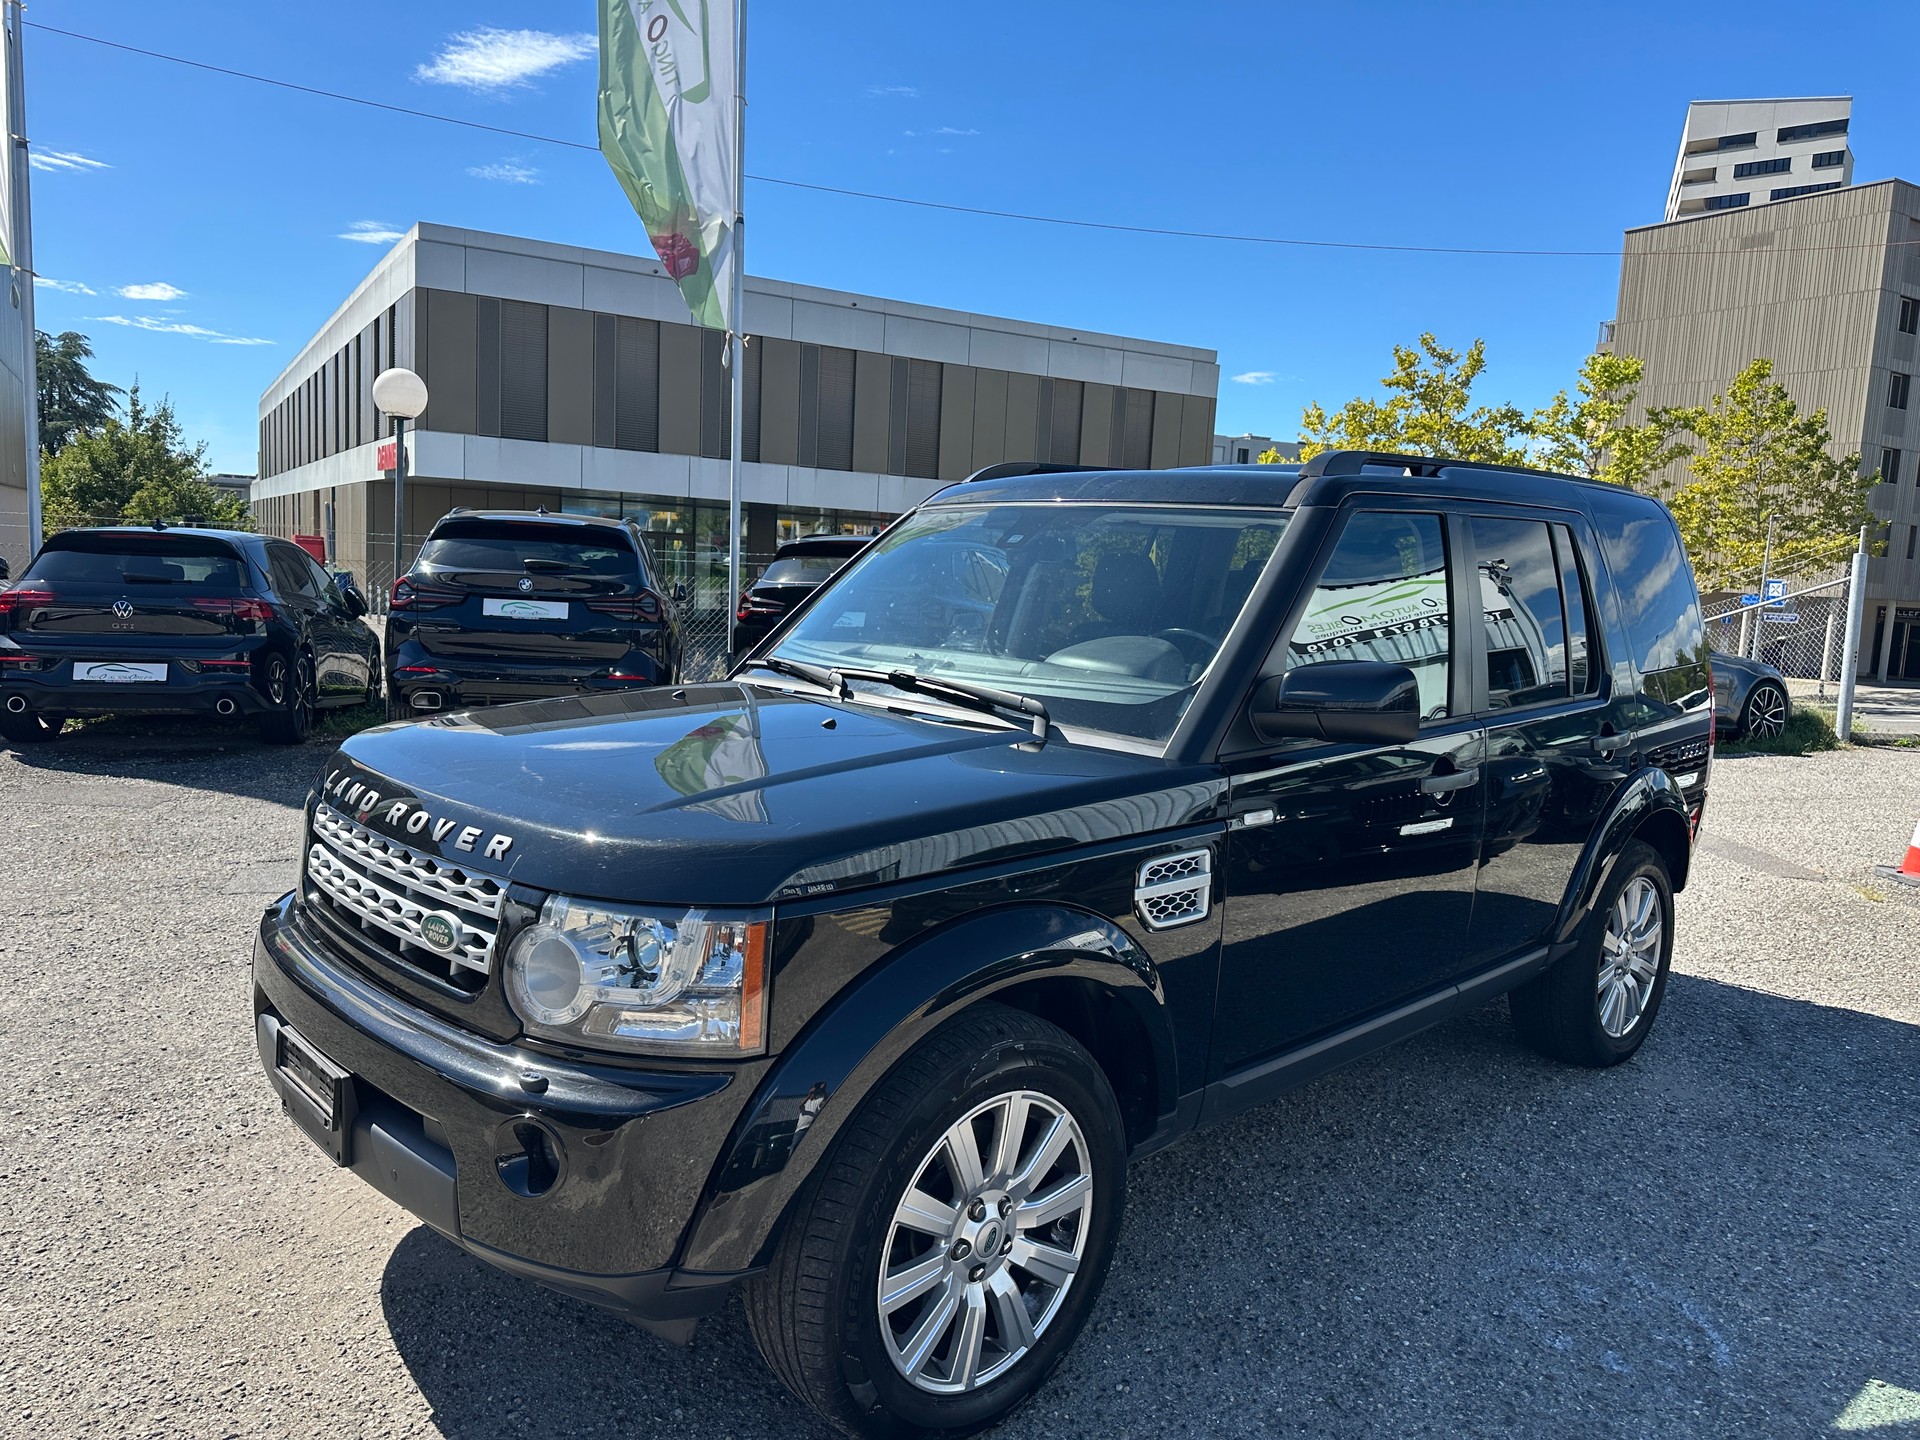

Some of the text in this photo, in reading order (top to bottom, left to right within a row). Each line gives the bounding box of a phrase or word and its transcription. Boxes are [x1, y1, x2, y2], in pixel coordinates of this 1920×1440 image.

[325, 769, 513, 861] LAND ROVER
[427, 921, 445, 934] LAND
[428, 931, 449, 945] ROVER
